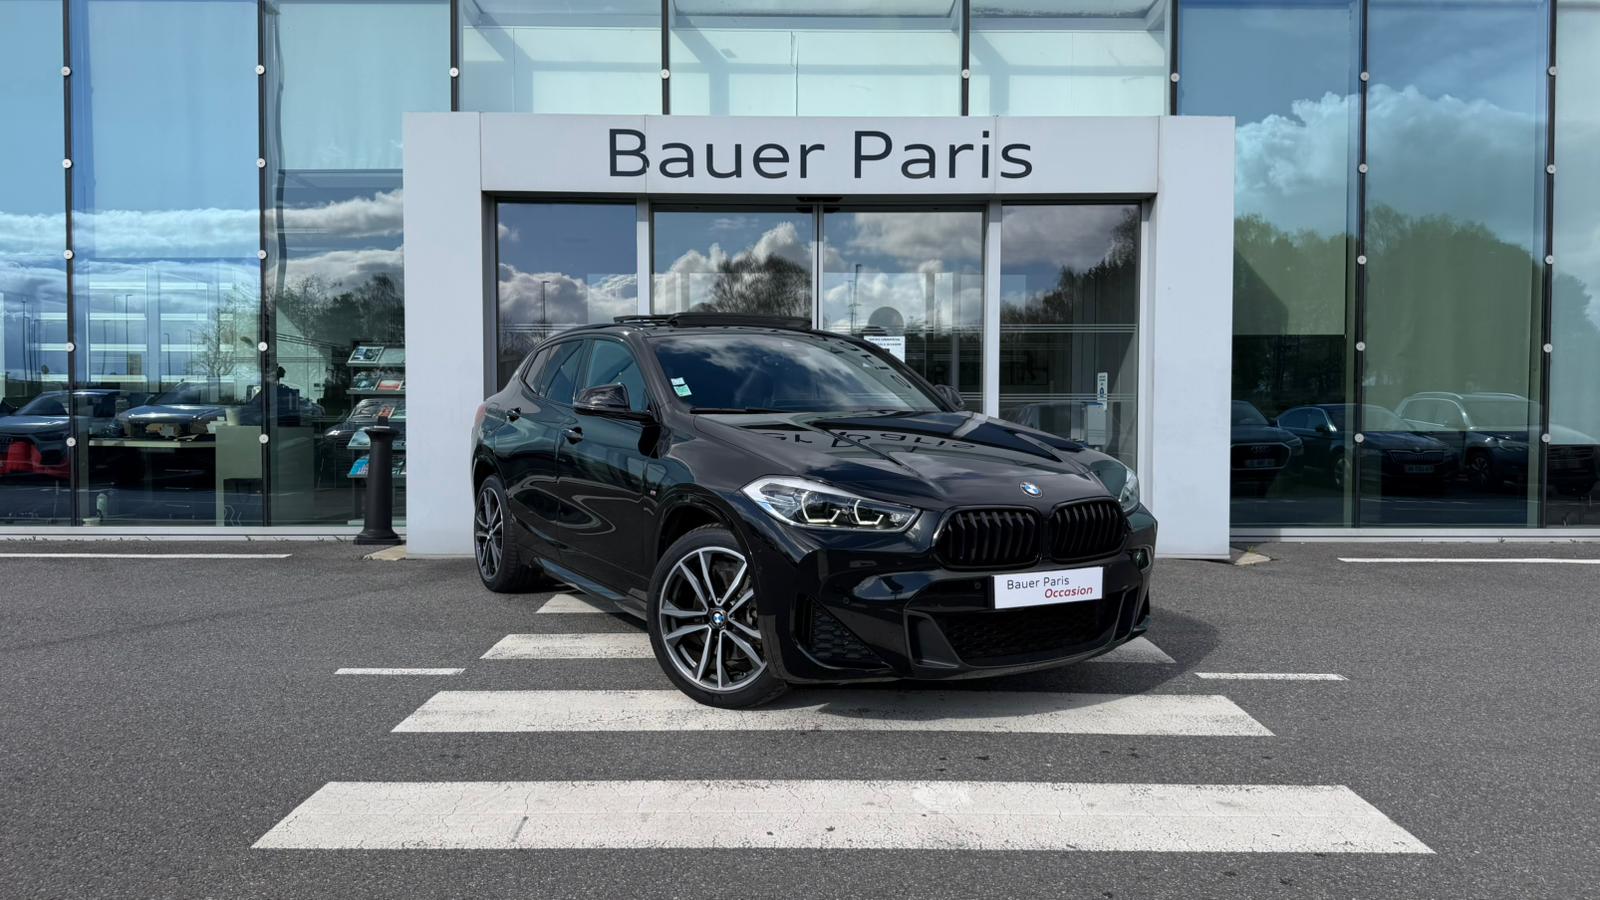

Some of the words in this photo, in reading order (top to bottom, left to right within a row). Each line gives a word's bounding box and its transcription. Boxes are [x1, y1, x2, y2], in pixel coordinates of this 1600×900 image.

[609, 128, 825, 179] Bauer
[854, 130, 1033, 181] Paris
[1007, 579, 1040, 590] Bauer
[1043, 576, 1070, 587] Paris
[1044, 586, 1093, 598] Occasion
